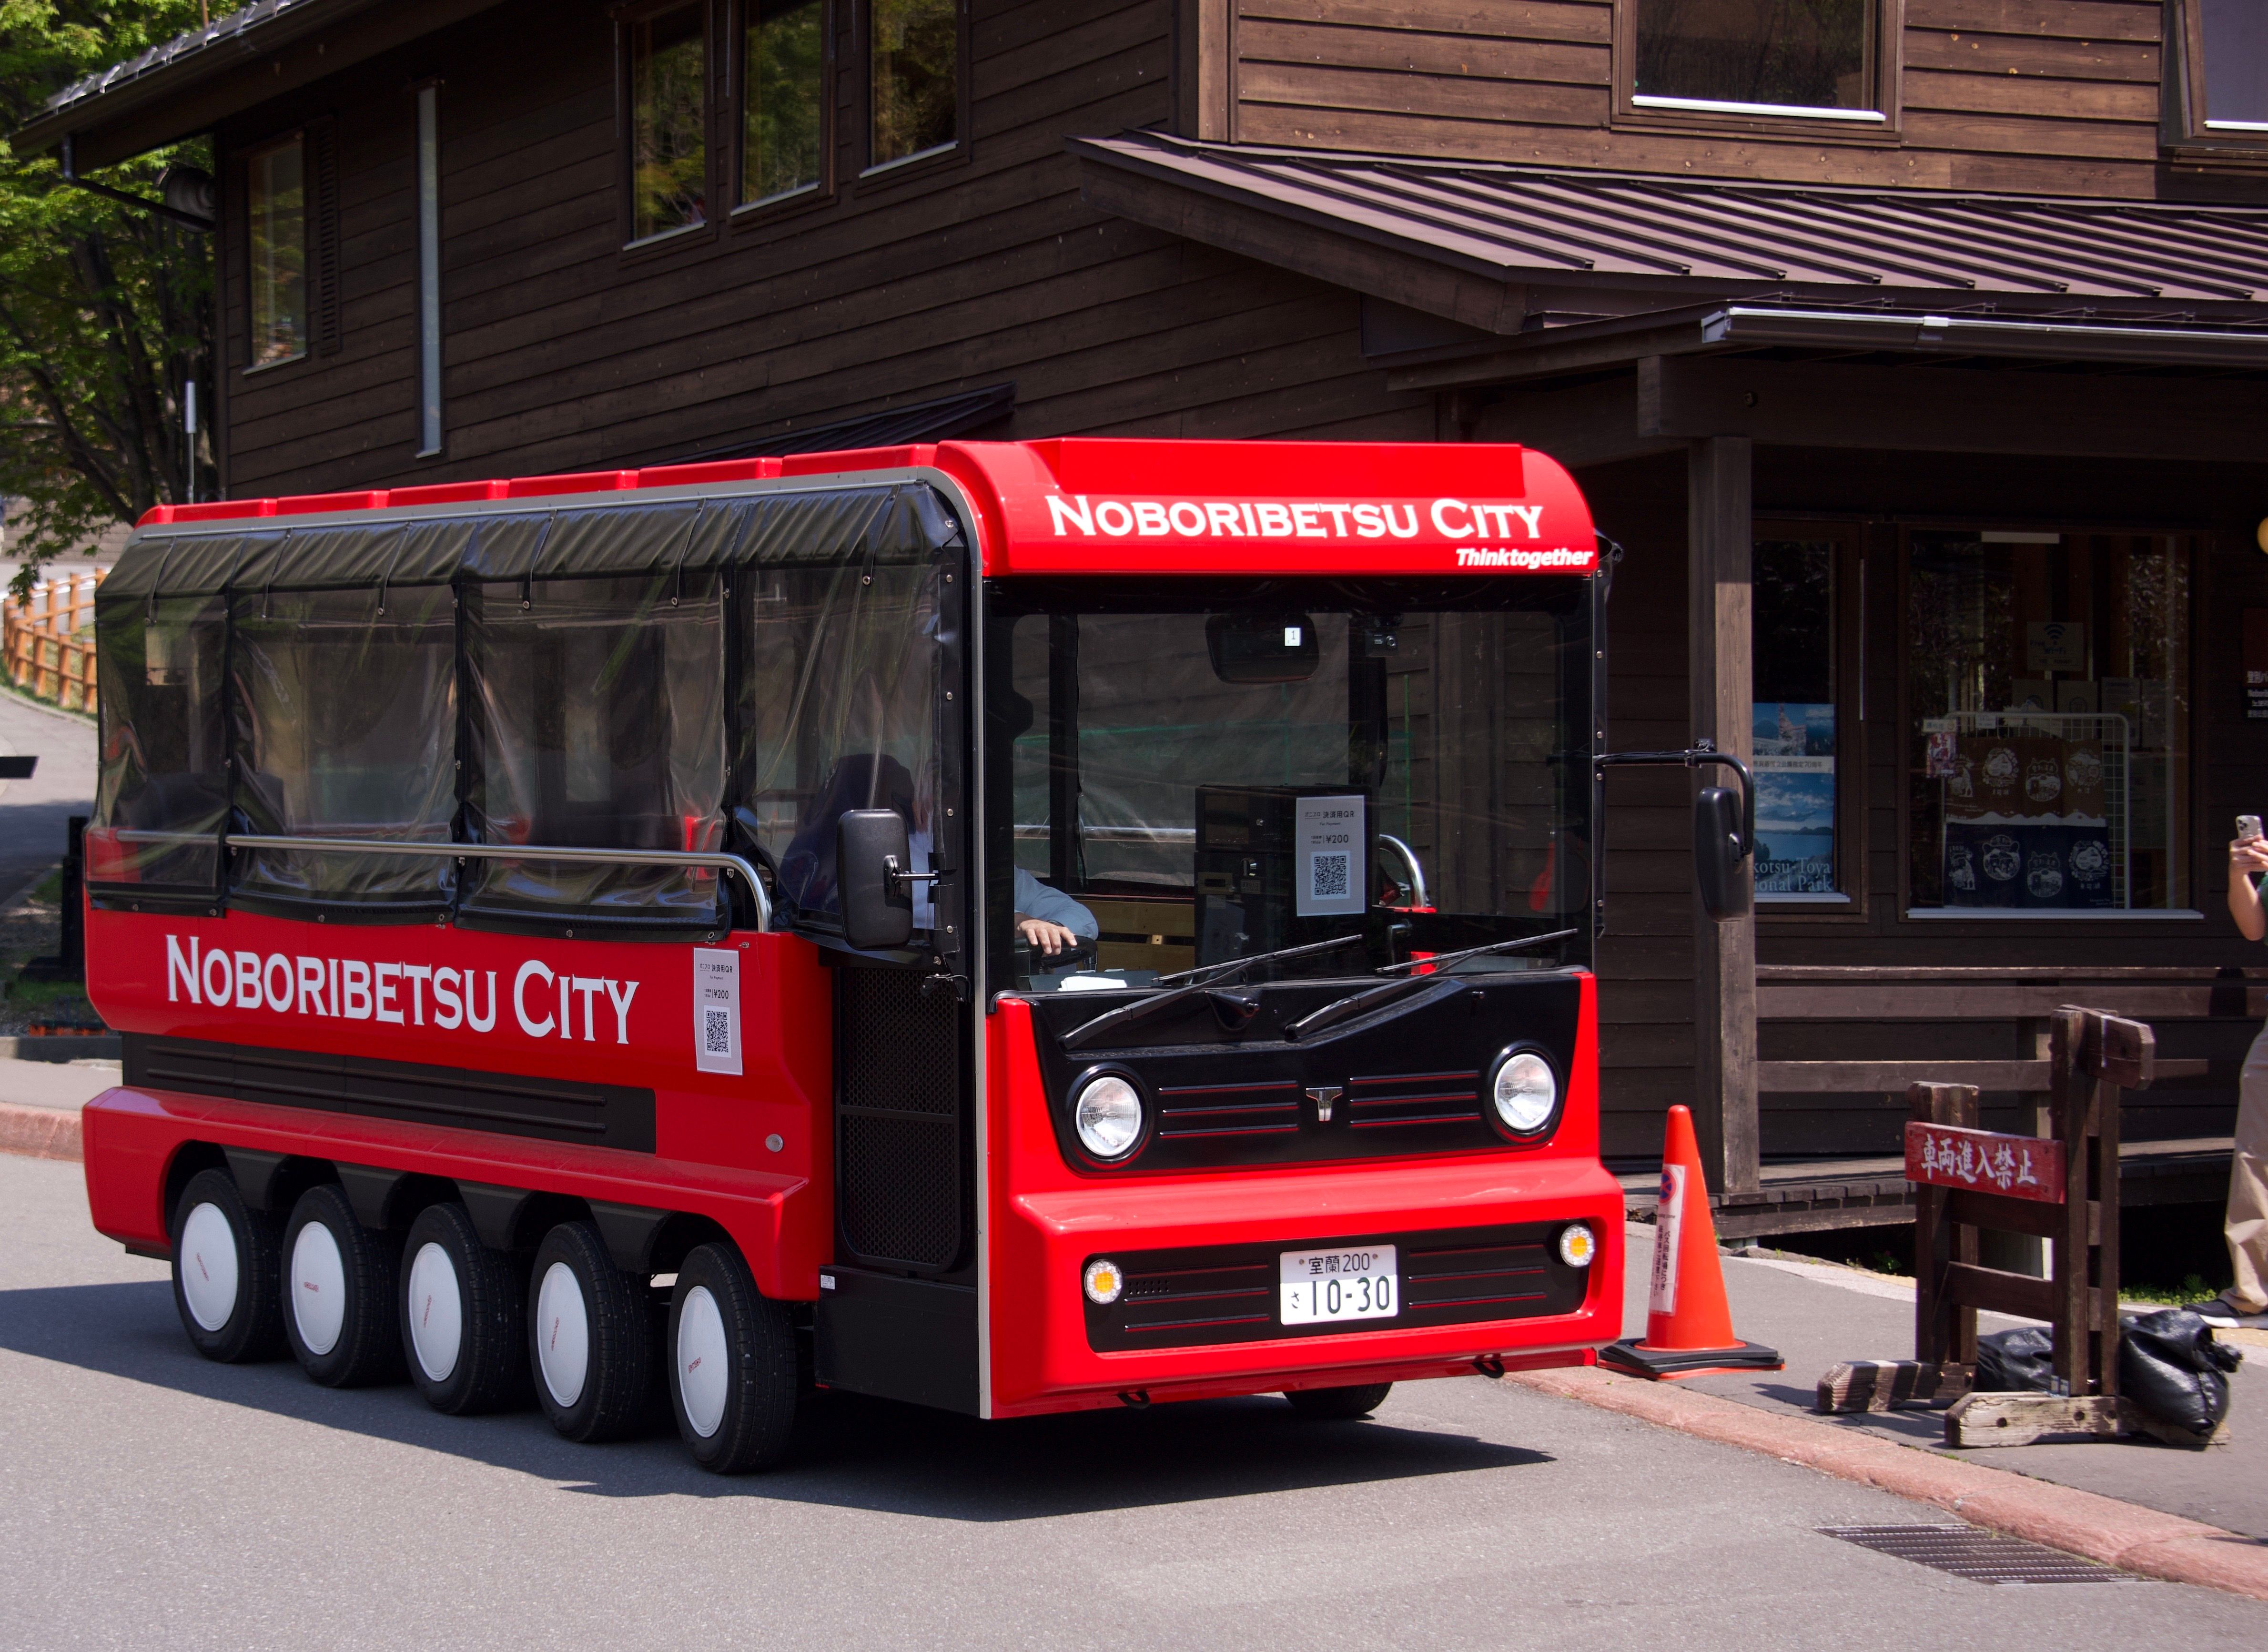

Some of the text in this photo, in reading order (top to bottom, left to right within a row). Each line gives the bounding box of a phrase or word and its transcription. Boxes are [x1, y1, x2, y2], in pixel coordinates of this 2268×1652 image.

[1045, 495, 1544, 539] NOBORIBETSU CITY
[1456, 547, 1594, 568] Thinktogether
[1326, 834, 1348, 843] ¥200
[1798, 875, 1833, 892] Park
[166, 934, 640, 1044] NOBORIBETSU CITY
[714, 989, 729, 999] ¥200
[1291, 1276, 1390, 1316] さ 10-30
